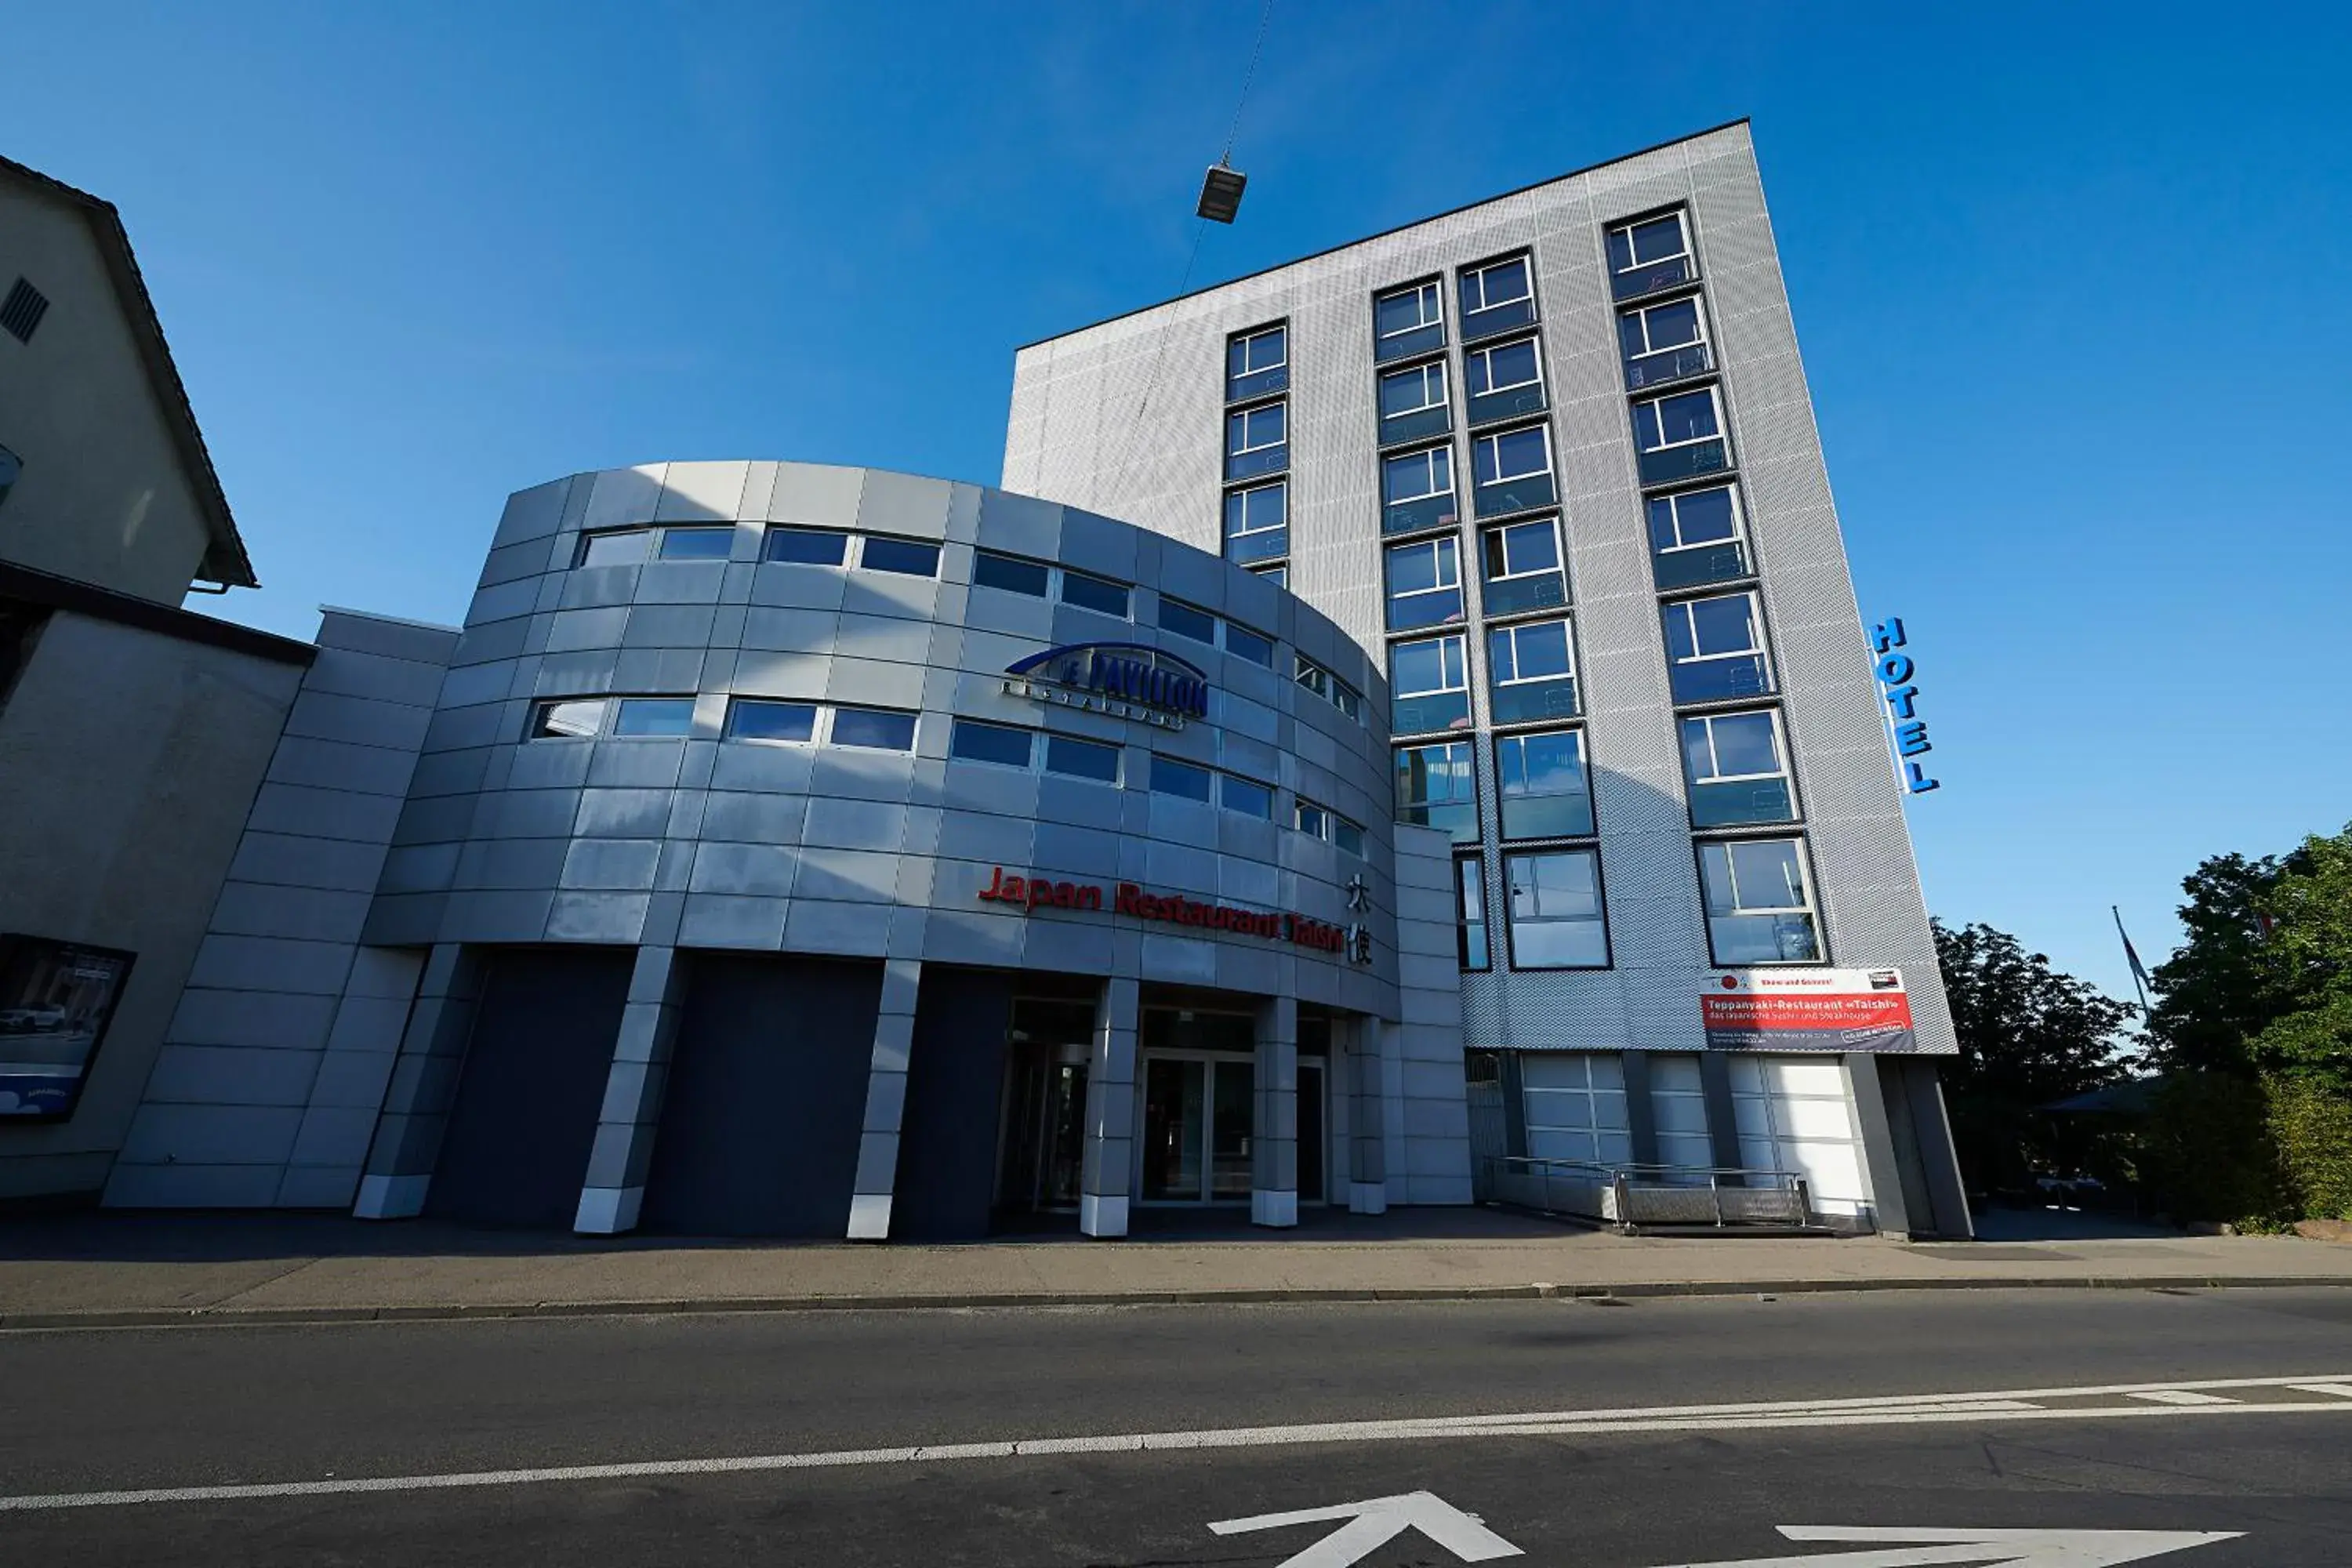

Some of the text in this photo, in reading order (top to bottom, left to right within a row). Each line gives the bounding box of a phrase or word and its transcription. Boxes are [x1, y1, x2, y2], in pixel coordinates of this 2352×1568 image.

[1870, 617, 1940, 793] HOTEL
[977, 866, 1102, 913] Japan
[1115, 880, 1281, 938] Restaurant
[1708, 999, 1843, 1012] Teppanyaki-Restaurant
